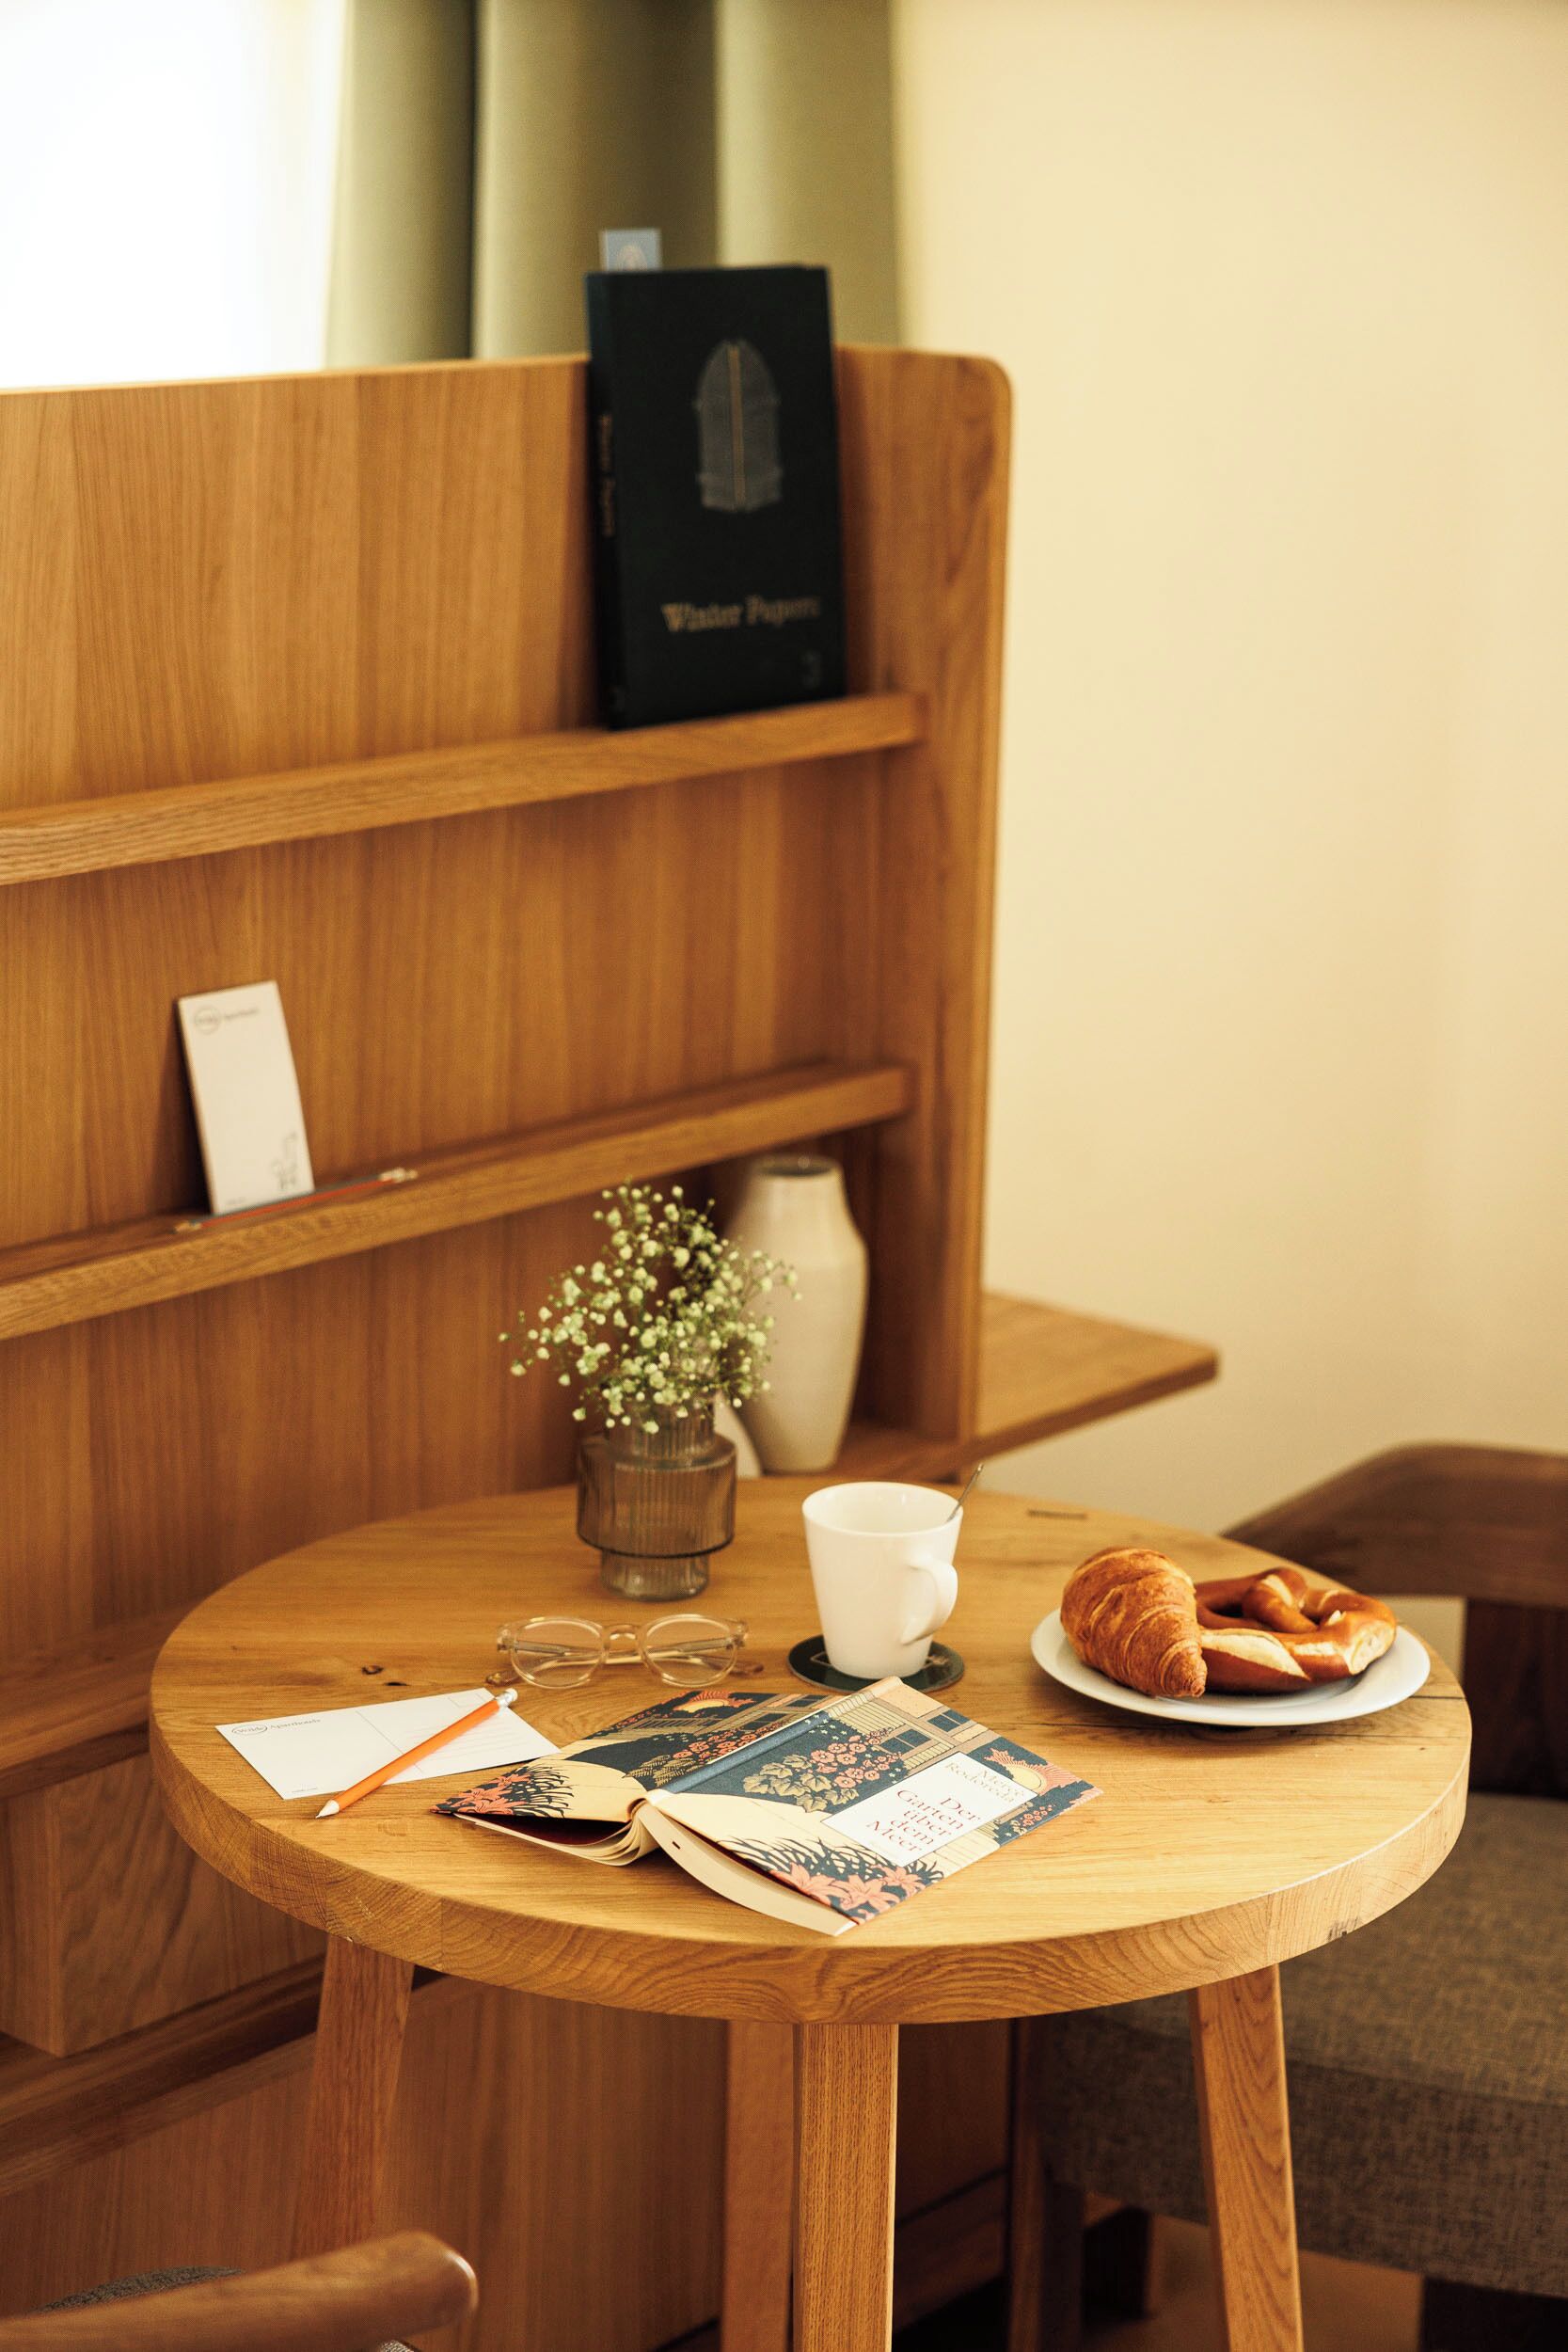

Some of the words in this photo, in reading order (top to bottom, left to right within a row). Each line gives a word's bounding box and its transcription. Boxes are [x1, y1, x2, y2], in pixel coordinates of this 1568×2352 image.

[661, 602, 742, 632] Winter
[745, 595, 820, 628] Papers
[897, 1790, 964, 1829] Garten
[903, 1809, 951, 1836] über
[941, 1798, 980, 1820] Der
[865, 1820, 922, 1851] Meer
[891, 1820, 934, 1844] dem
